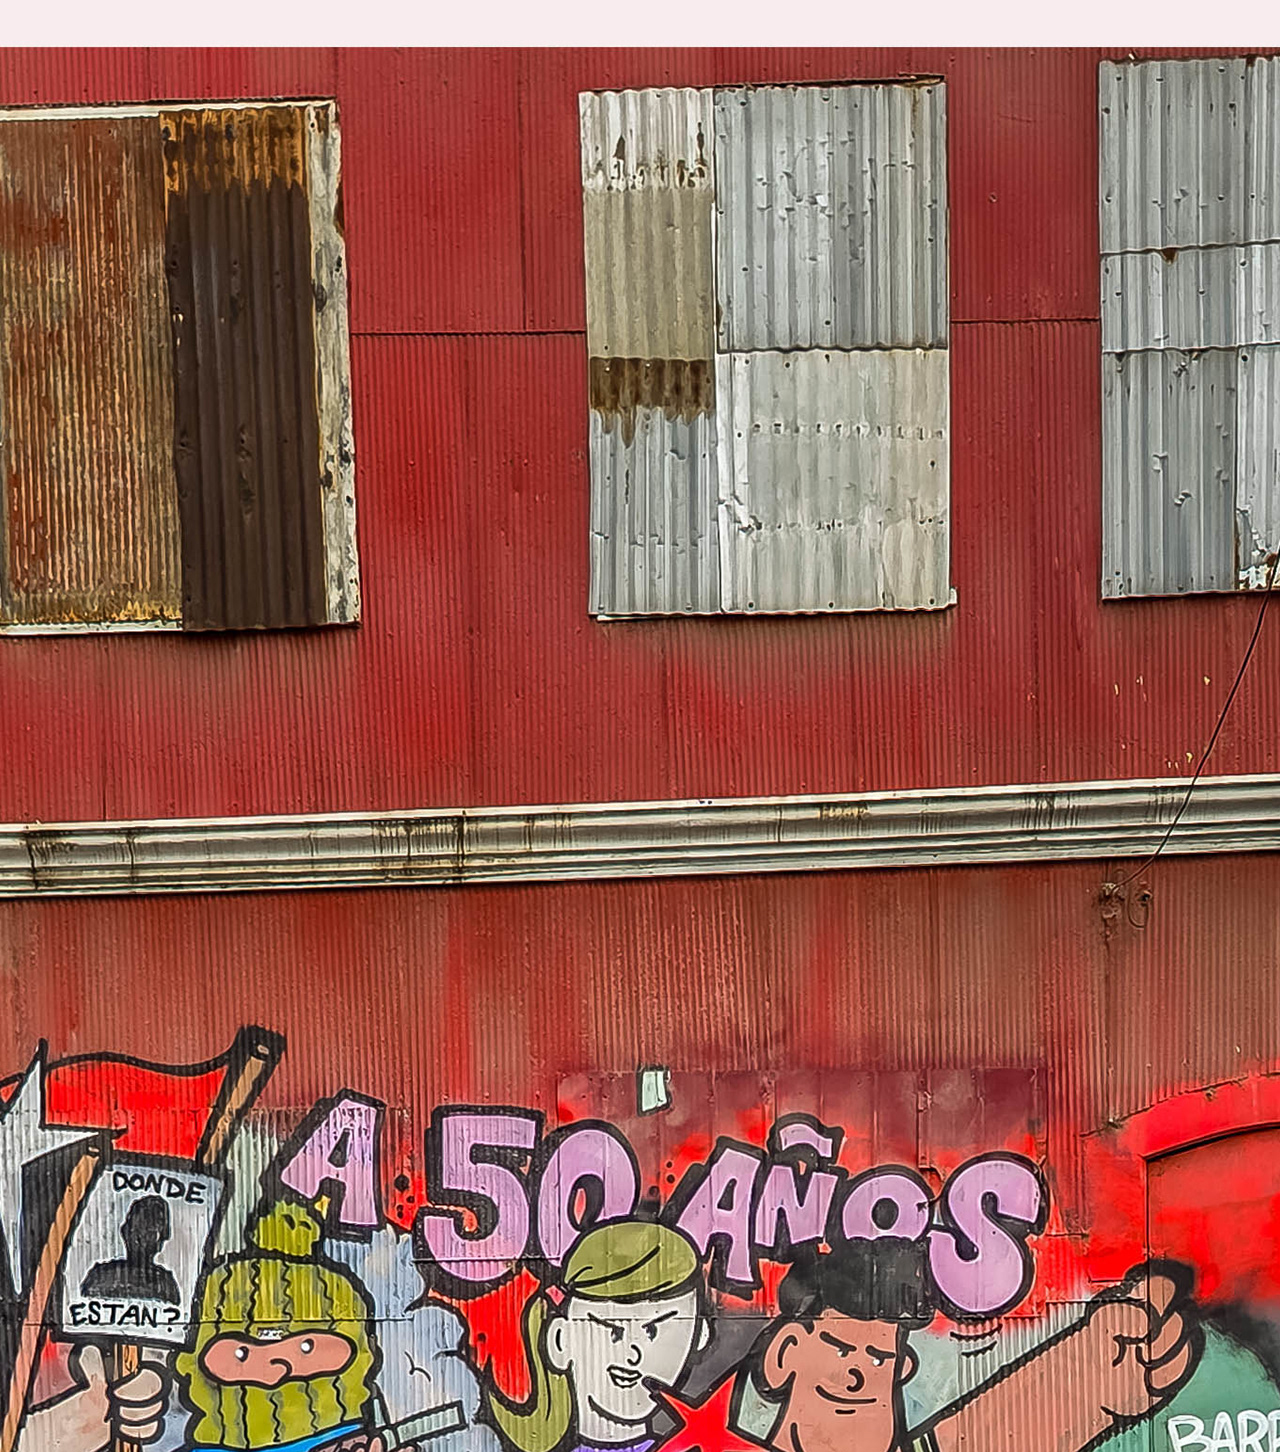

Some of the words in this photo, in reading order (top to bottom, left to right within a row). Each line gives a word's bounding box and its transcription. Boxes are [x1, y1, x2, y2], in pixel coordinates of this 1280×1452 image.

[112, 1170, 207, 1205] DONDE
[281, 1097, 382, 1227] A
[423, 1112, 638, 1281] 50
[679, 1123, 1041, 1312] AÑOS
[68, 1300, 181, 1333] ESTAN?
